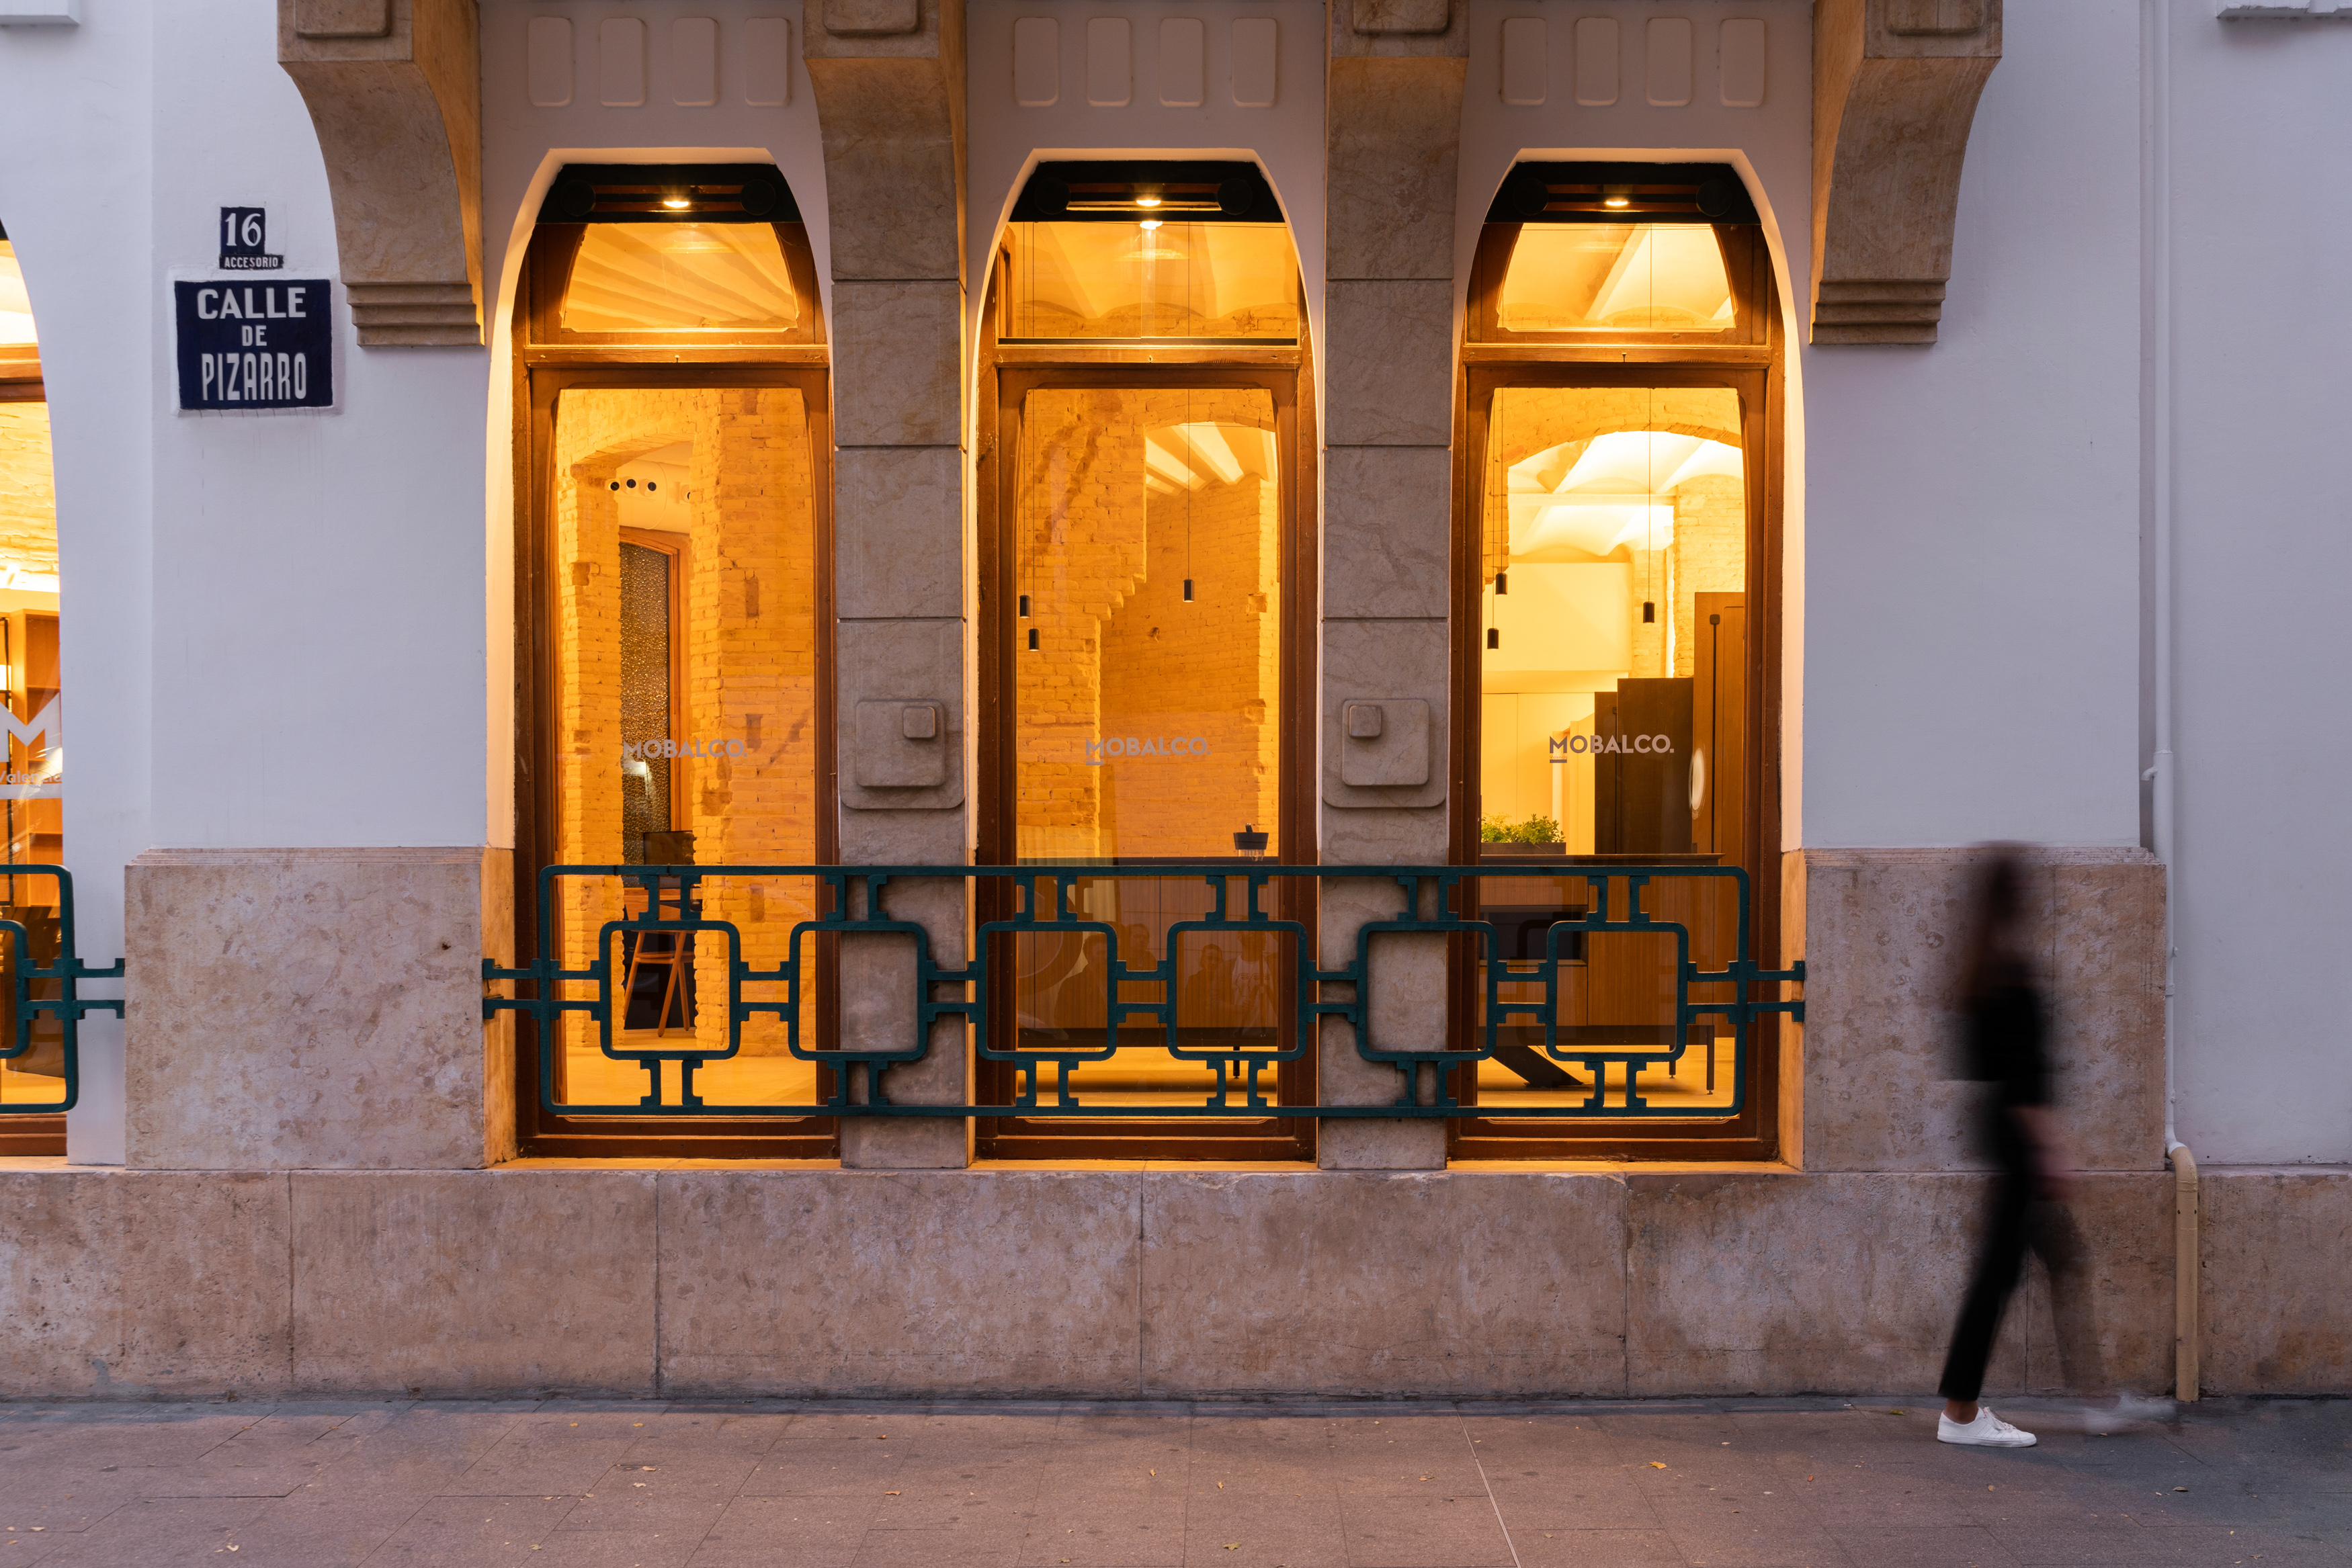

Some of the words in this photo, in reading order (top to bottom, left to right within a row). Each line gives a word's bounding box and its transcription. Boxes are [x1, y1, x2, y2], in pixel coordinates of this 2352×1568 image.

[224, 212, 262, 247] 16
[224, 256, 278, 269] ACCESORIO
[197, 286, 307, 320] CALLE
[241, 324, 267, 347] DE
[202, 352, 307, 401] PIZARRO
[623, 738, 748, 758] MOBALCO.
[1085, 736, 1211, 756] MOBALCO.
[1549, 734, 1675, 754] MOBALCO.
